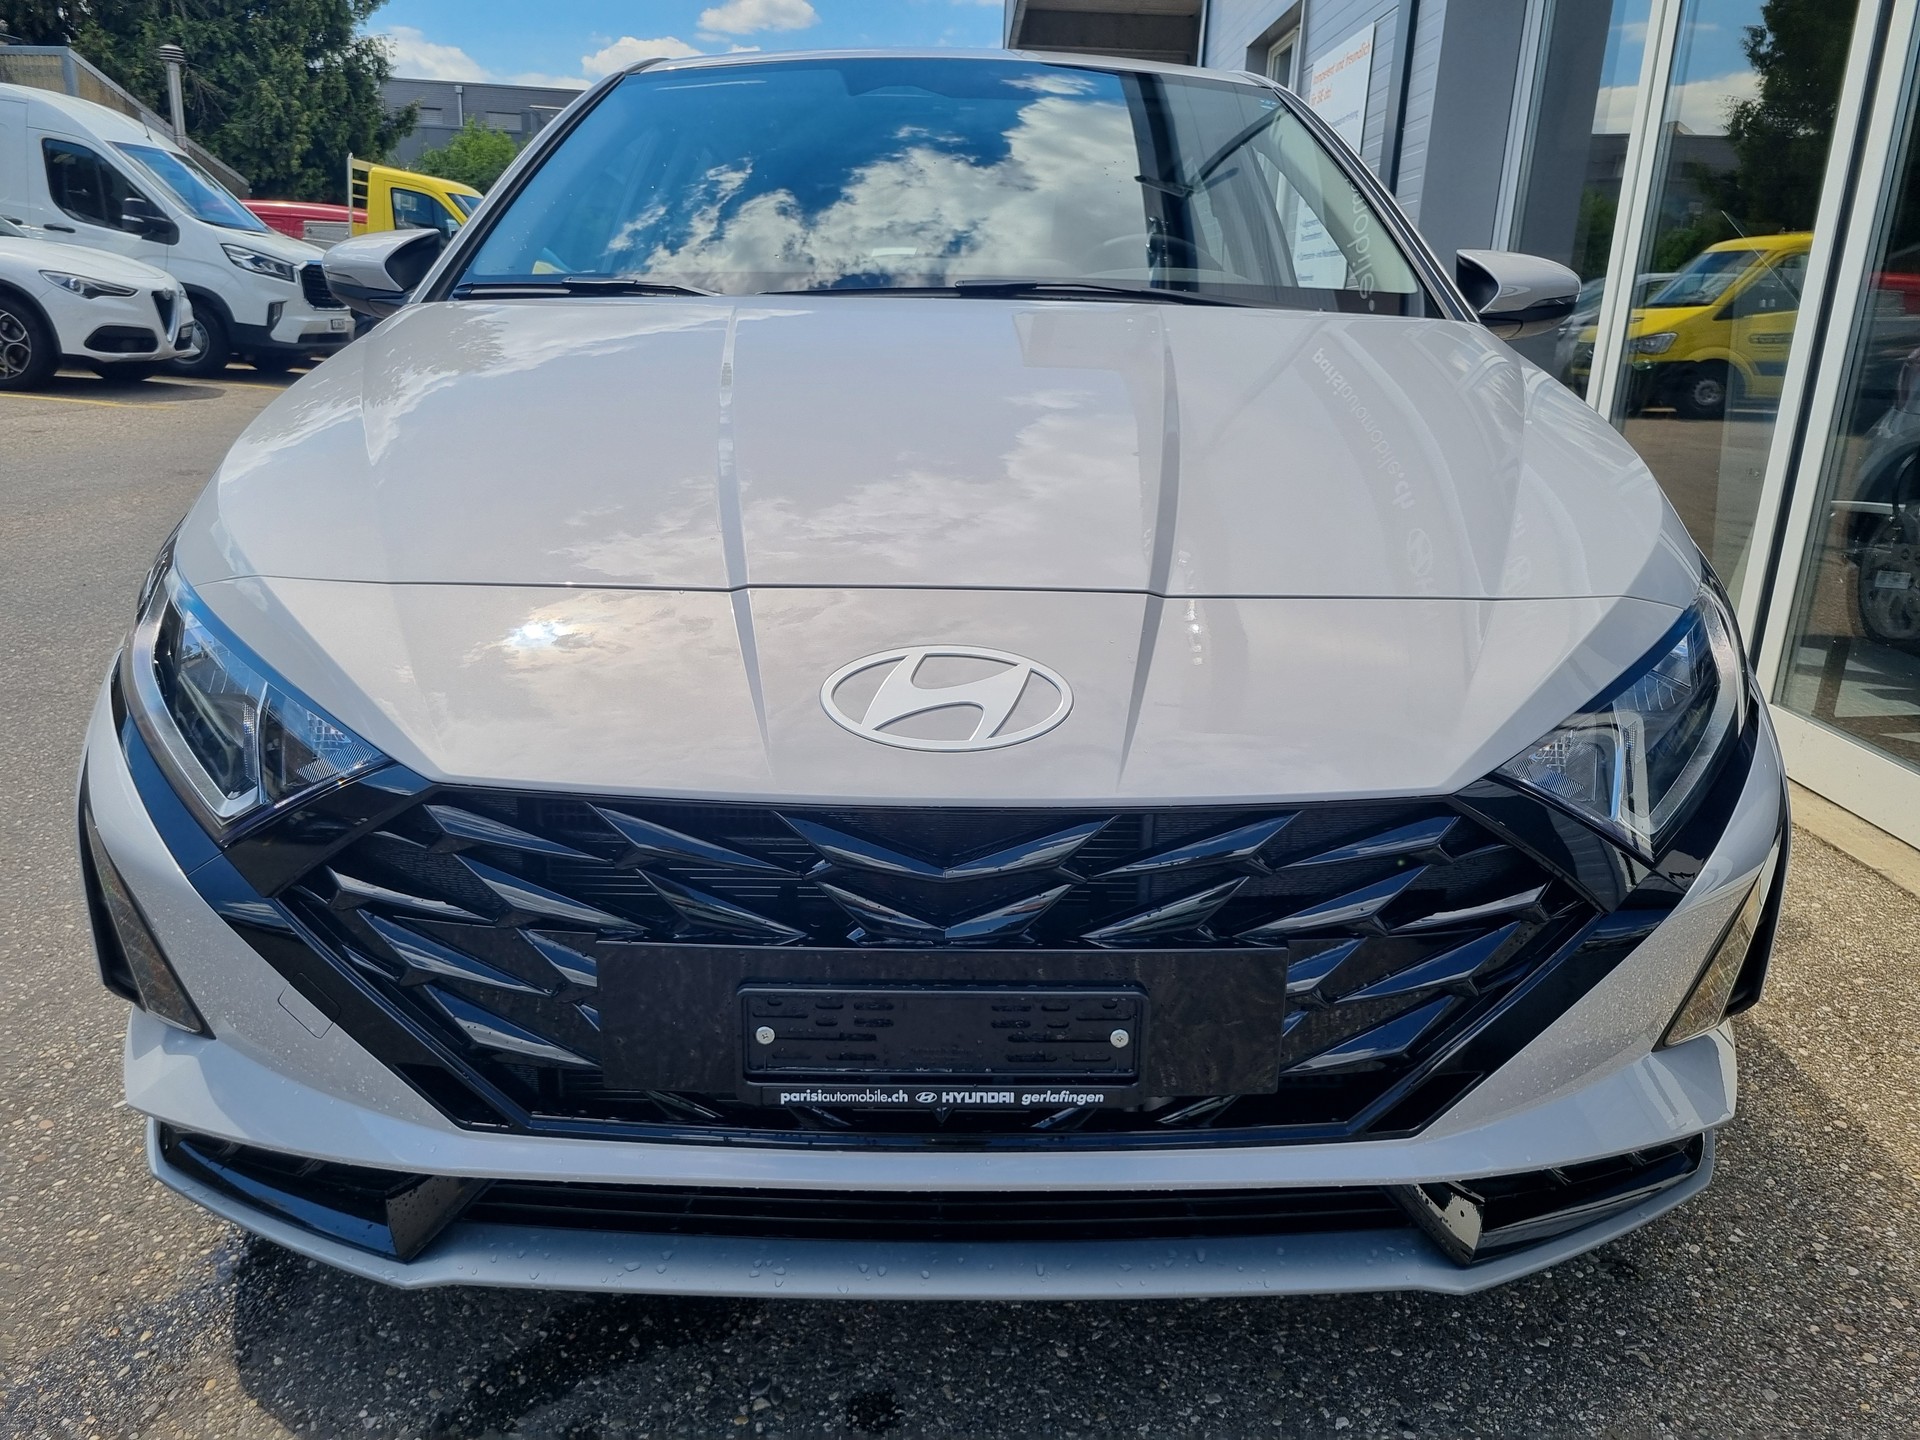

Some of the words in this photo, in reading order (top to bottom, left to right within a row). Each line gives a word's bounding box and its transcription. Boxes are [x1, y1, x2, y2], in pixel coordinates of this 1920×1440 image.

[780, 1089, 908, 1104] parisiautomobile.ch
[941, 1091, 1015, 1104] HYUNDAI
[1021, 1090, 1104, 1106] gerlafingen
